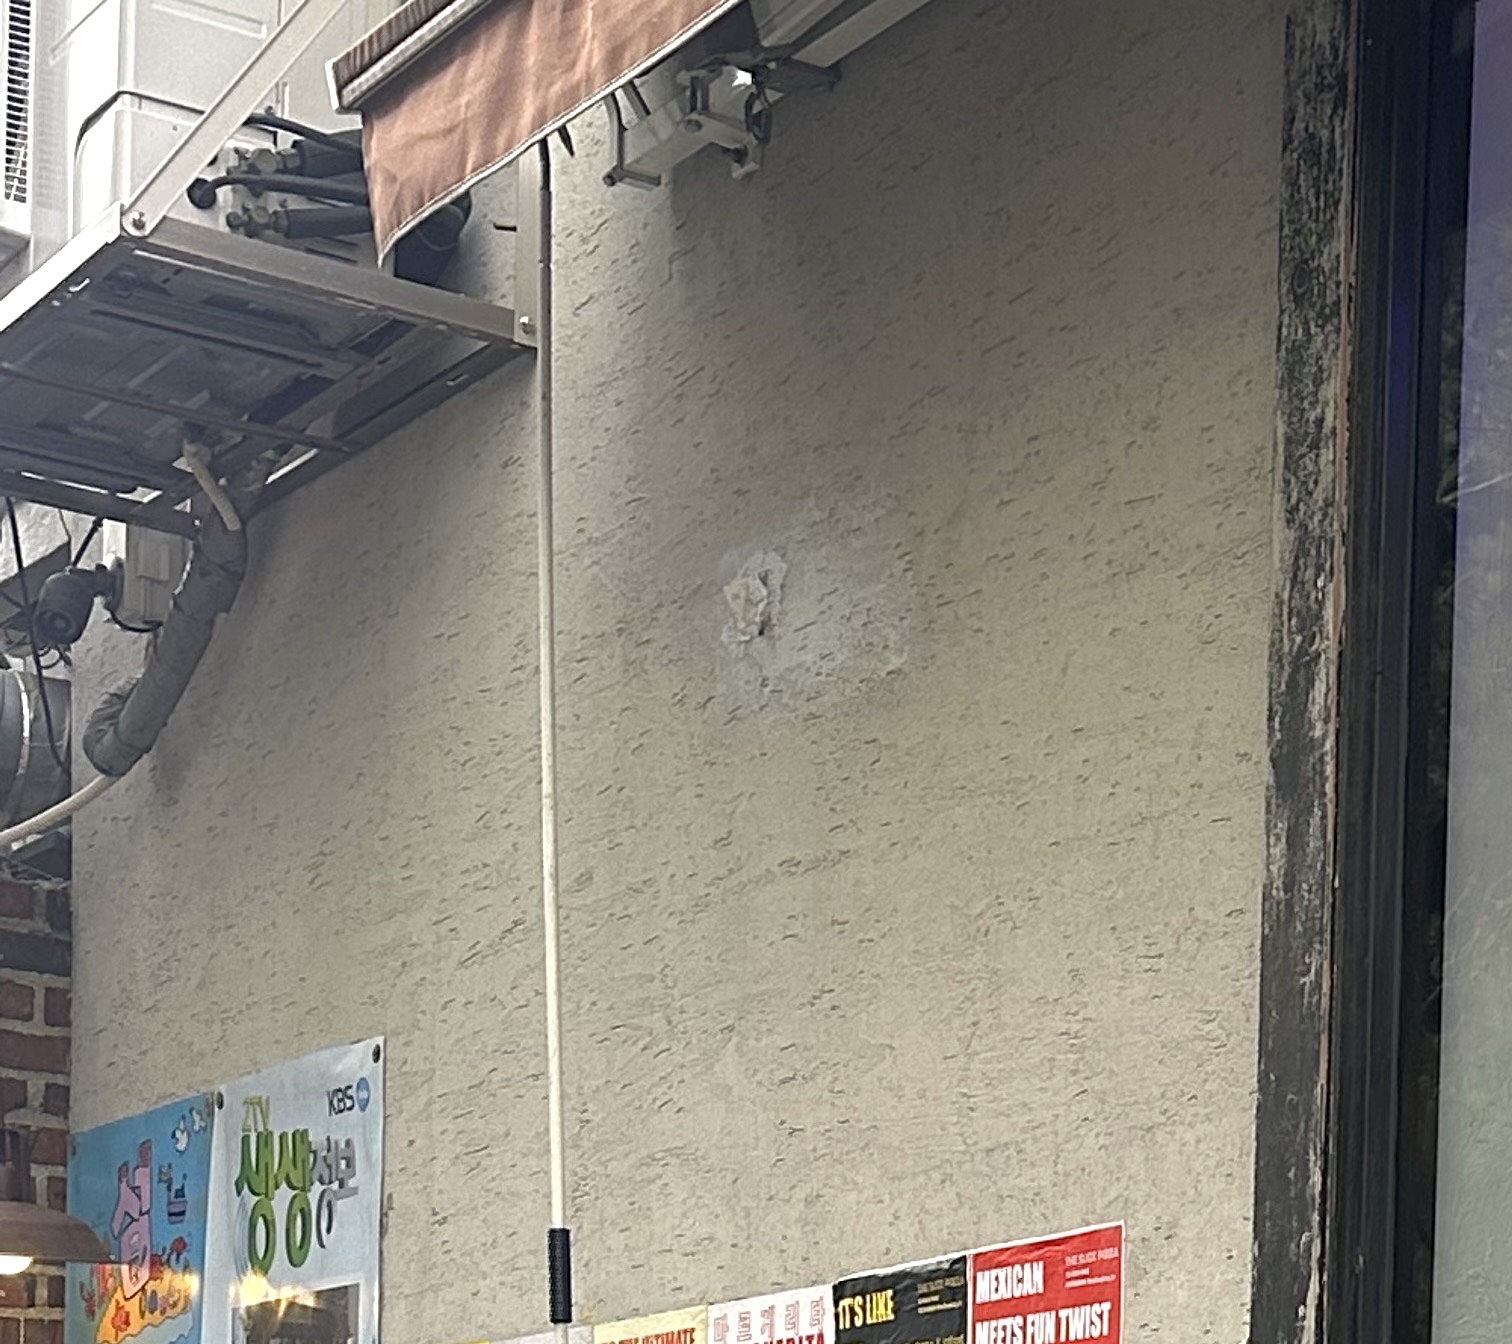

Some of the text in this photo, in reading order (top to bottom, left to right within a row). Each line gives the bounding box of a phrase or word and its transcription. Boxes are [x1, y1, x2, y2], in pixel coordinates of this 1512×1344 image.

[327, 1085, 355, 1116] KBS
[976, 1261, 1044, 1304] MEXICAN
[837, 1297, 863, 1330] IT'S
[866, 1289, 895, 1324] LIKE
[1059, 1301, 1112, 1342] TWIST
